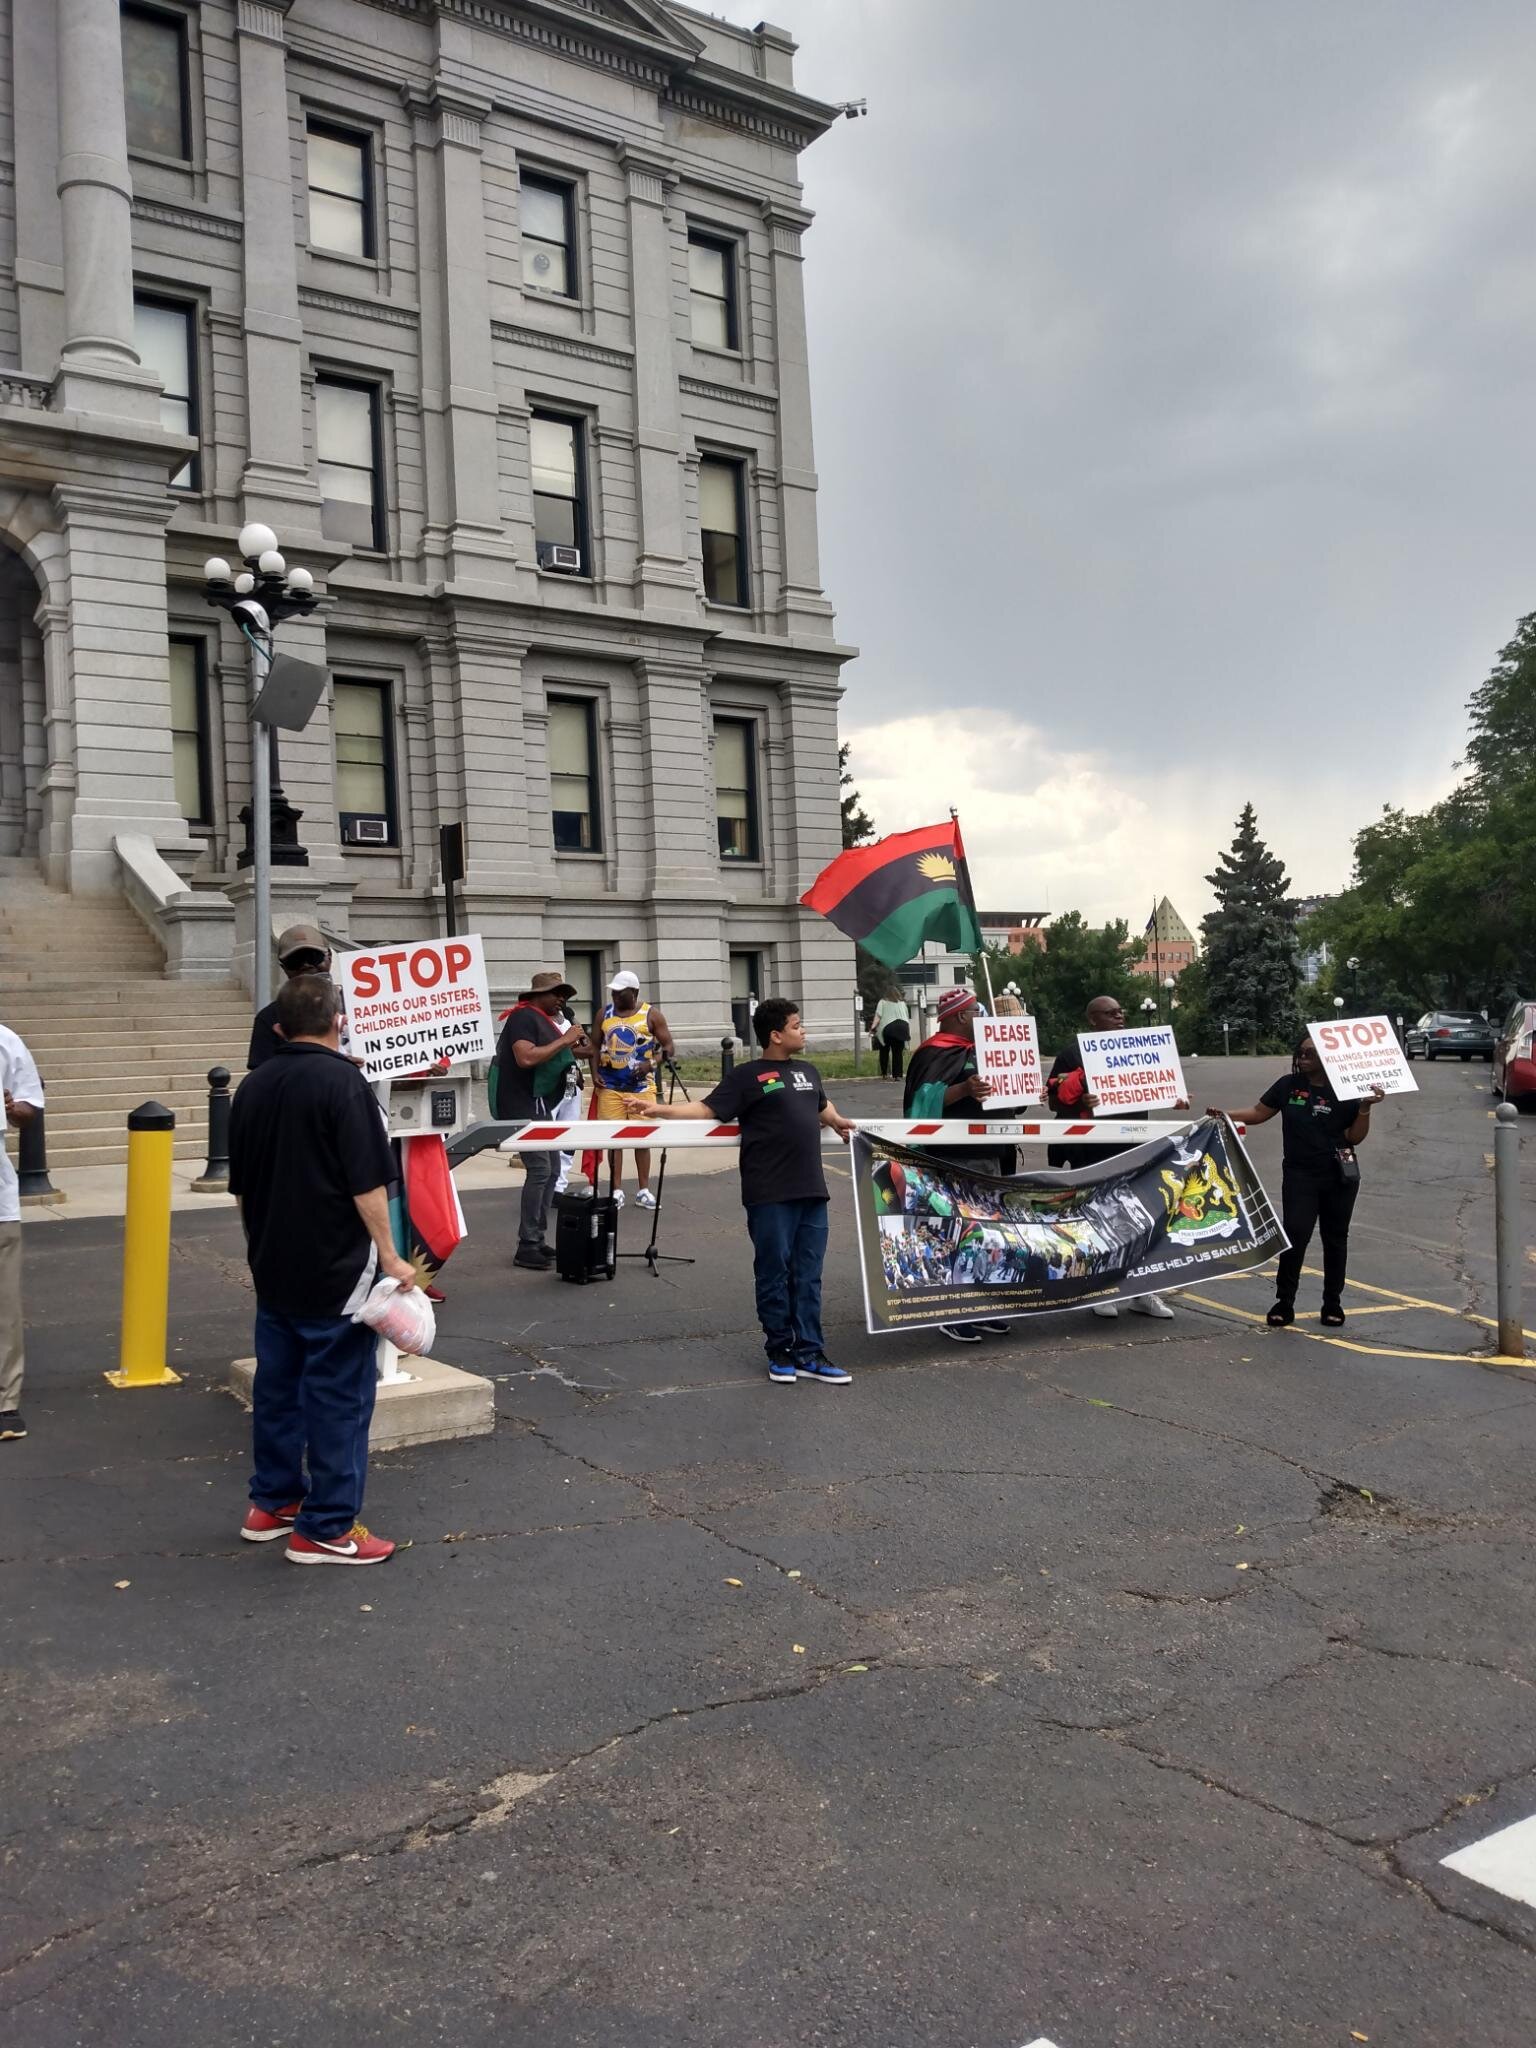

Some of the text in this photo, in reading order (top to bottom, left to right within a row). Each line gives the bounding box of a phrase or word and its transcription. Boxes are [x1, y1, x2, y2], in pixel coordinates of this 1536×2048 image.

[351, 944, 472, 998] STOP
[354, 988, 479, 1019] RAPING OUR SISTERS,
[355, 1002, 481, 1034] CHILDREN AND MOTHERS
[365, 1020, 480, 1054] IN SOUTH EAST
[984, 1024, 1030, 1042] PLEASE
[1083, 1033, 1172, 1052] US GOVERNMENT
[1320, 1022, 1387, 1050] STOP
[366, 1039, 484, 1074] NIGERIA NOW!!!
[985, 1049, 1035, 1068] HELP US
[1106, 1052, 1160, 1068] SANCTION
[1325, 1048, 1400, 1064] KILLINGS FARMERS
[1338, 1058, 1396, 1072] IN THEIR LAND
[1092, 1069, 1175, 1089] THE NIGERIAN
[1352, 1072, 1381, 1082] SOUTH
[1382, 1069, 1403, 1078] EAST
[1101, 1086, 1178, 1105] PRESIDENT!!!
[1126, 1262, 1166, 1279] PLEASE
[1166, 1255, 1194, 1270] HELP
[1196, 1252, 1211, 1262] US
[1211, 1245, 1239, 1259] SAVE
